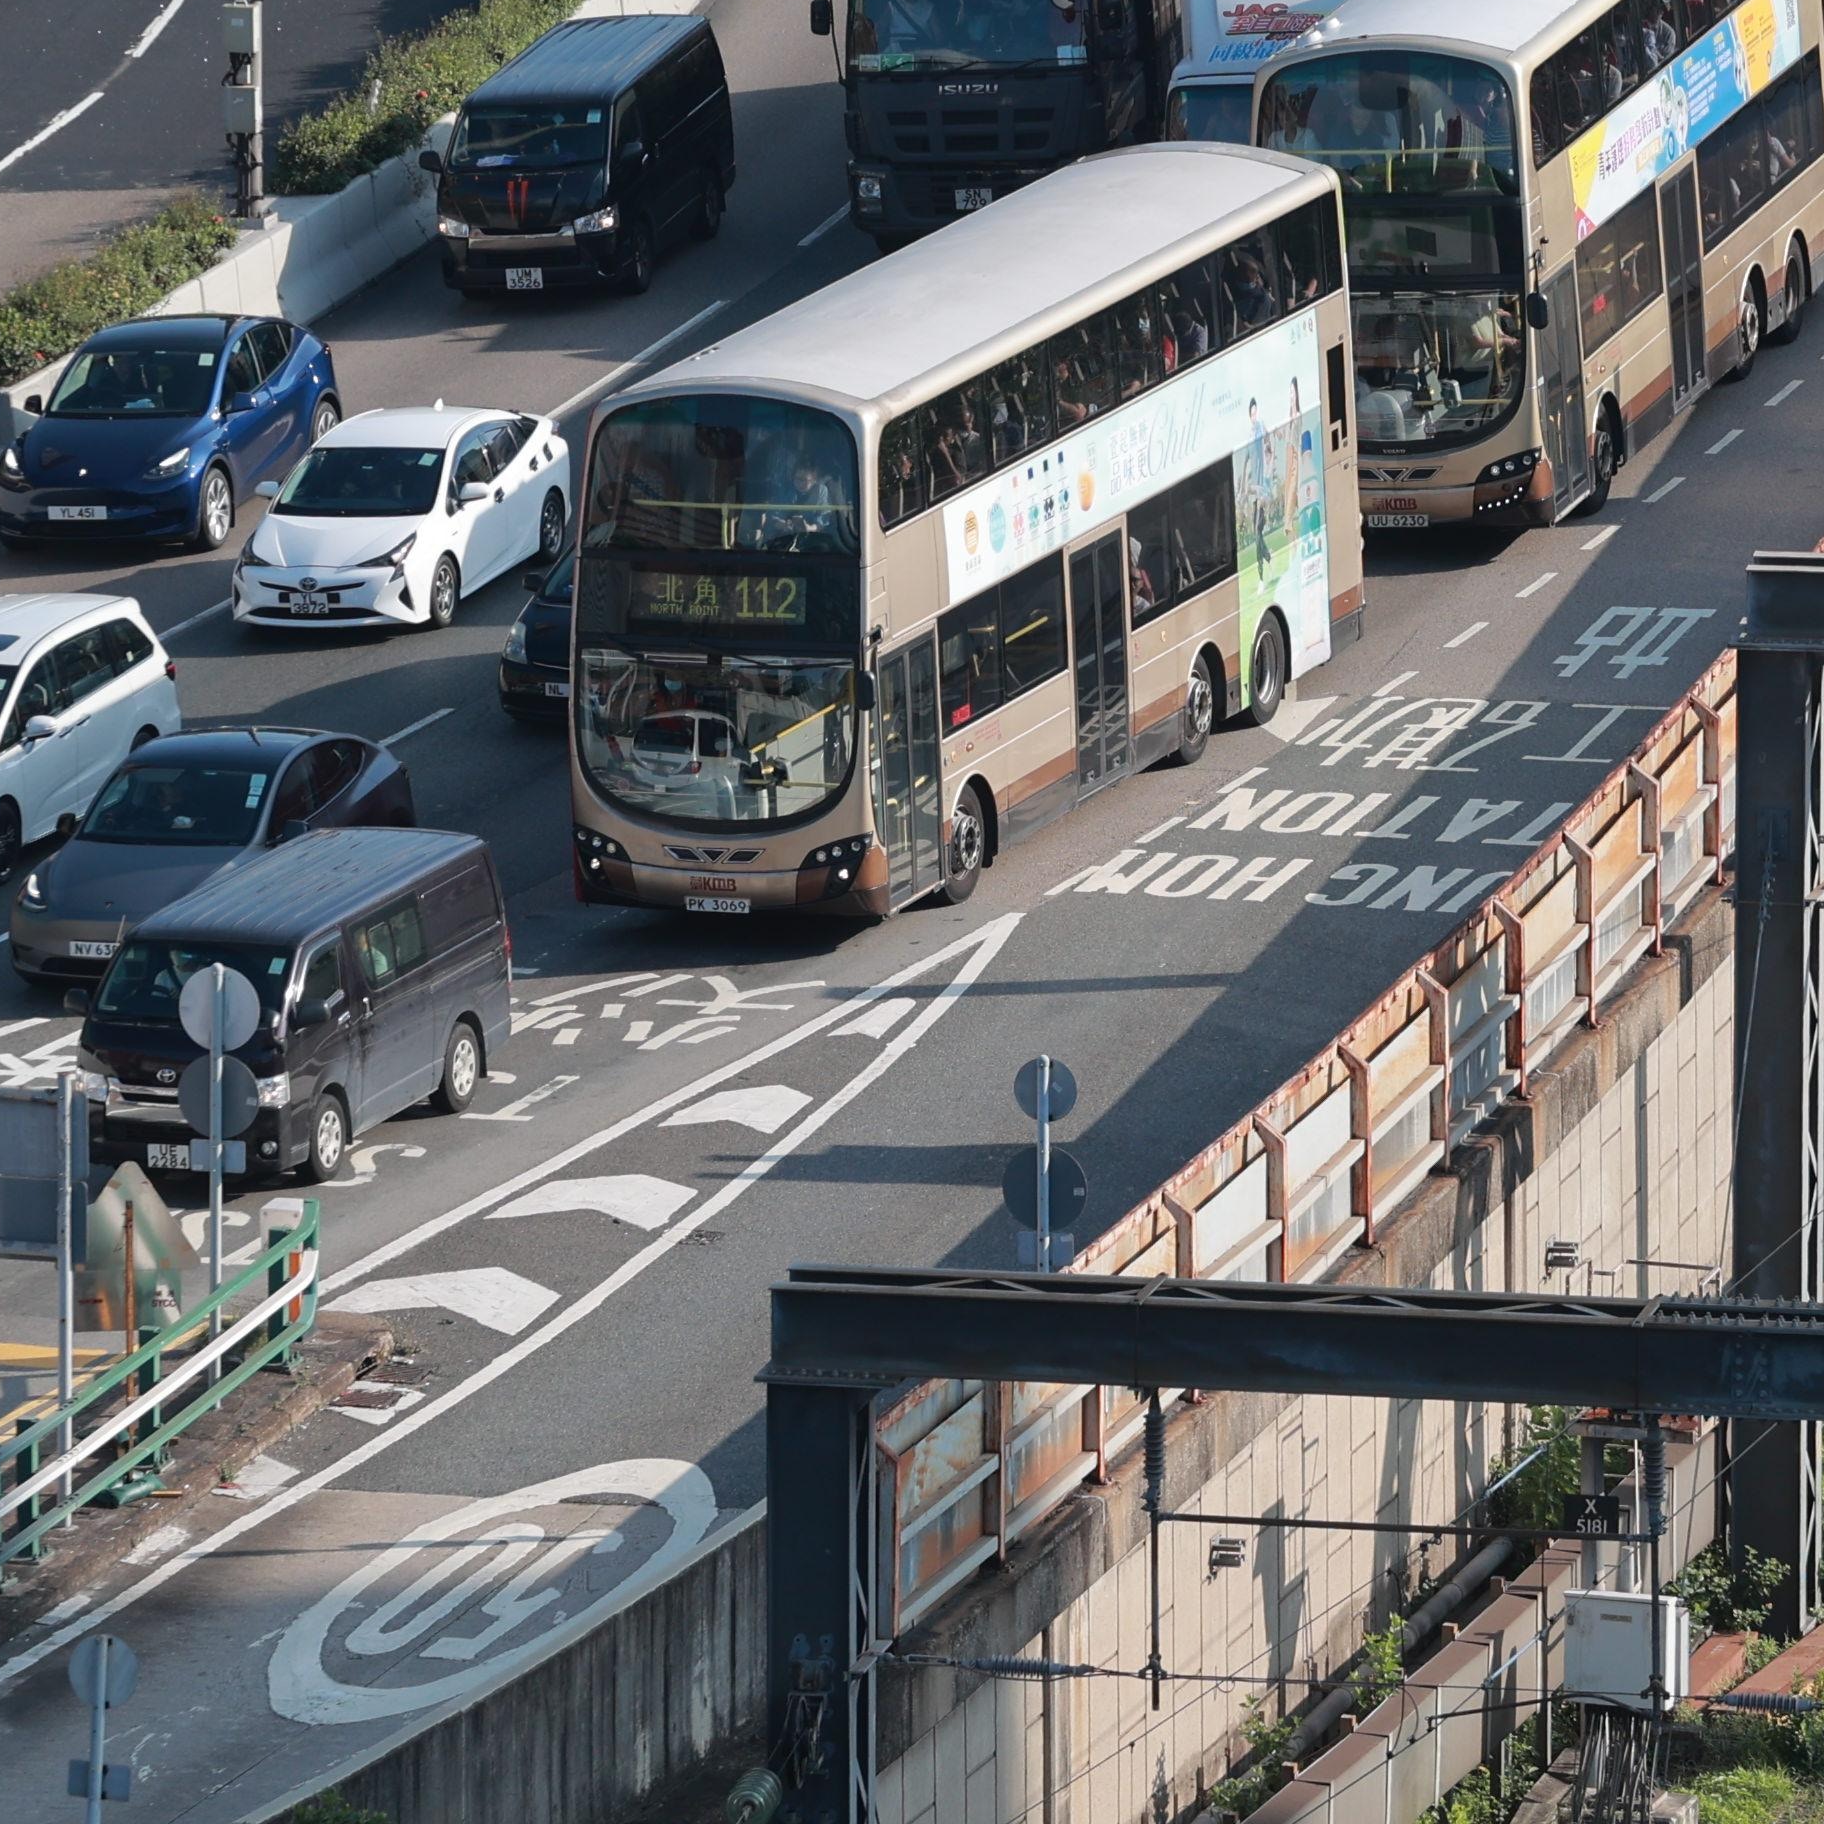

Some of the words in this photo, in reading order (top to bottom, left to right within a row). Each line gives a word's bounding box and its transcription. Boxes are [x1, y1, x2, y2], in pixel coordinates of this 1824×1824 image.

[1223, 3, 1289, 18] JAC
[937, 83, 999, 96] ISUZU
[965, 189, 982, 199] SN
[961, 198, 987, 210] 799
[515, 268, 532, 278] UM
[509, 277, 542, 289] 3526
[1385, 497, 1418, 511] KMB
[60, 507, 75, 518] YL
[76, 507, 95, 518] 451
[1371, 516, 1388, 527] UU
[1392, 515, 1426, 527] 6230
[656, 574, 719, 604] 北角
[299, 592, 314, 602] YL
[735, 575, 798, 619] 112
[292, 602, 327, 613] 3872
[649, 603, 683, 615] NORTH
[689, 604, 721, 617] POINT
[1552, 605, 1717, 680] 站
[548, 684, 564, 695] NL
[1186, 787, 1575, 848] TATION
[703, 877, 737, 892] KMB
[1305, 862, 1515, 914] UNG
[688, 898, 705, 910] PK
[712, 900, 747, 912] 3069
[75, 945, 93, 956] NV
[159, 1145, 176, 1156] UE
[150, 1156, 188, 1169] 2284
[1585, 1498, 1597, 1515] X
[1576, 1517, 1607, 1534] 5181
